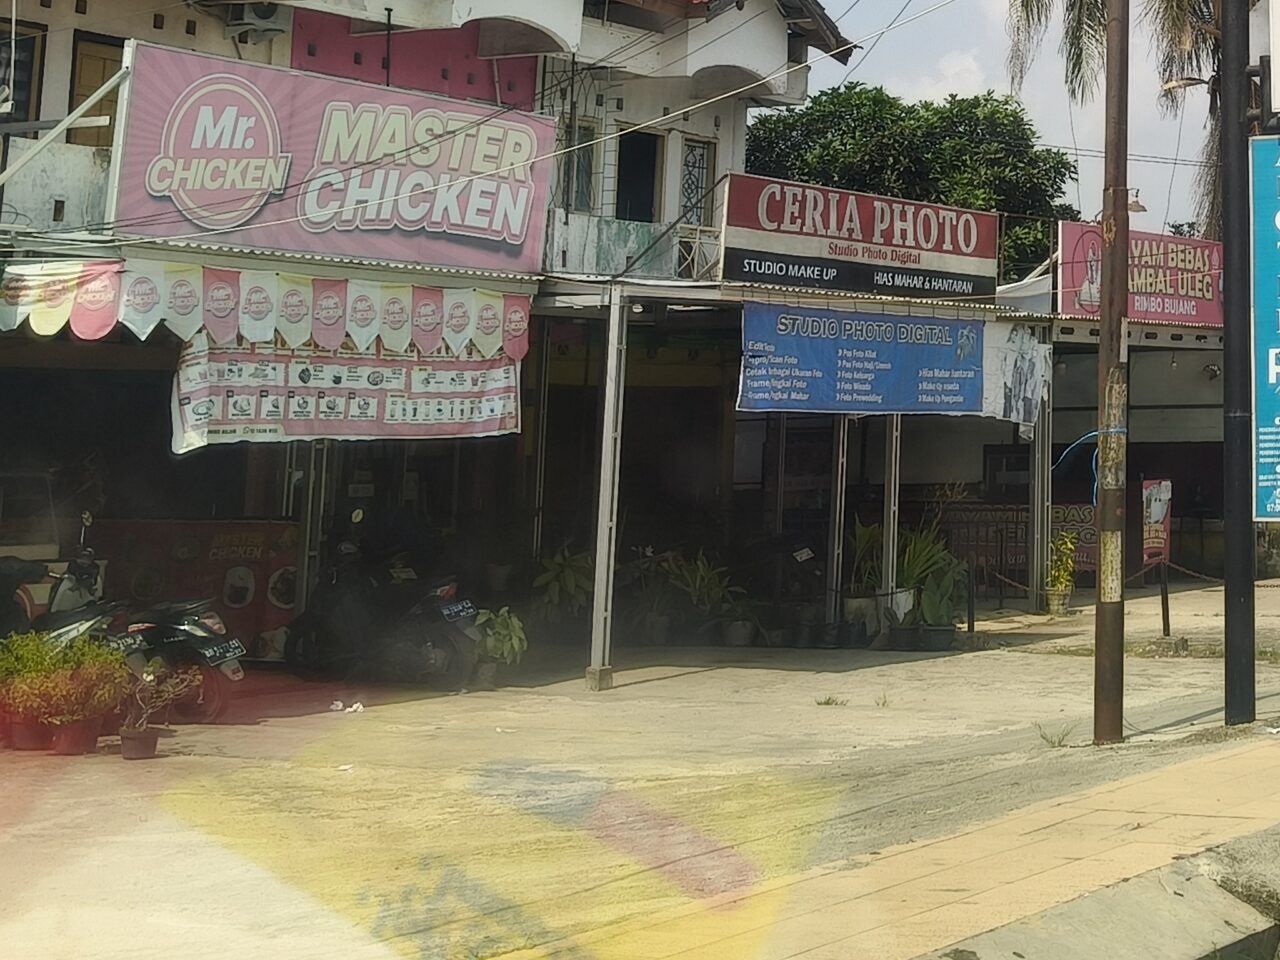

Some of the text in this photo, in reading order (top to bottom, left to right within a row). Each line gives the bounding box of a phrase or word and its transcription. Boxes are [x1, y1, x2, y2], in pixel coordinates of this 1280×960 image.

[190, 105, 255, 151] Mr.
[319, 108, 534, 181] MASTER
[148, 157, 288, 192] CHICKEN
[303, 168, 531, 237] CHICKEN
[757, 183, 978, 254] CERIA PHOTO
[828, 242, 921, 265] Studio Photo Digital
[1167, 242, 1211, 272] BEBAS
[743, 258, 838, 281] STUDIO MAKE UP
[874, 271, 973, 294] HIAS MAHAR & HANTARAN
[1176, 272, 1213, 300] ULEG
[1134, 295, 1197, 315] RIMBO BUJANG
[776, 314, 953, 345] STUDIO PHOTO DIGITAL
